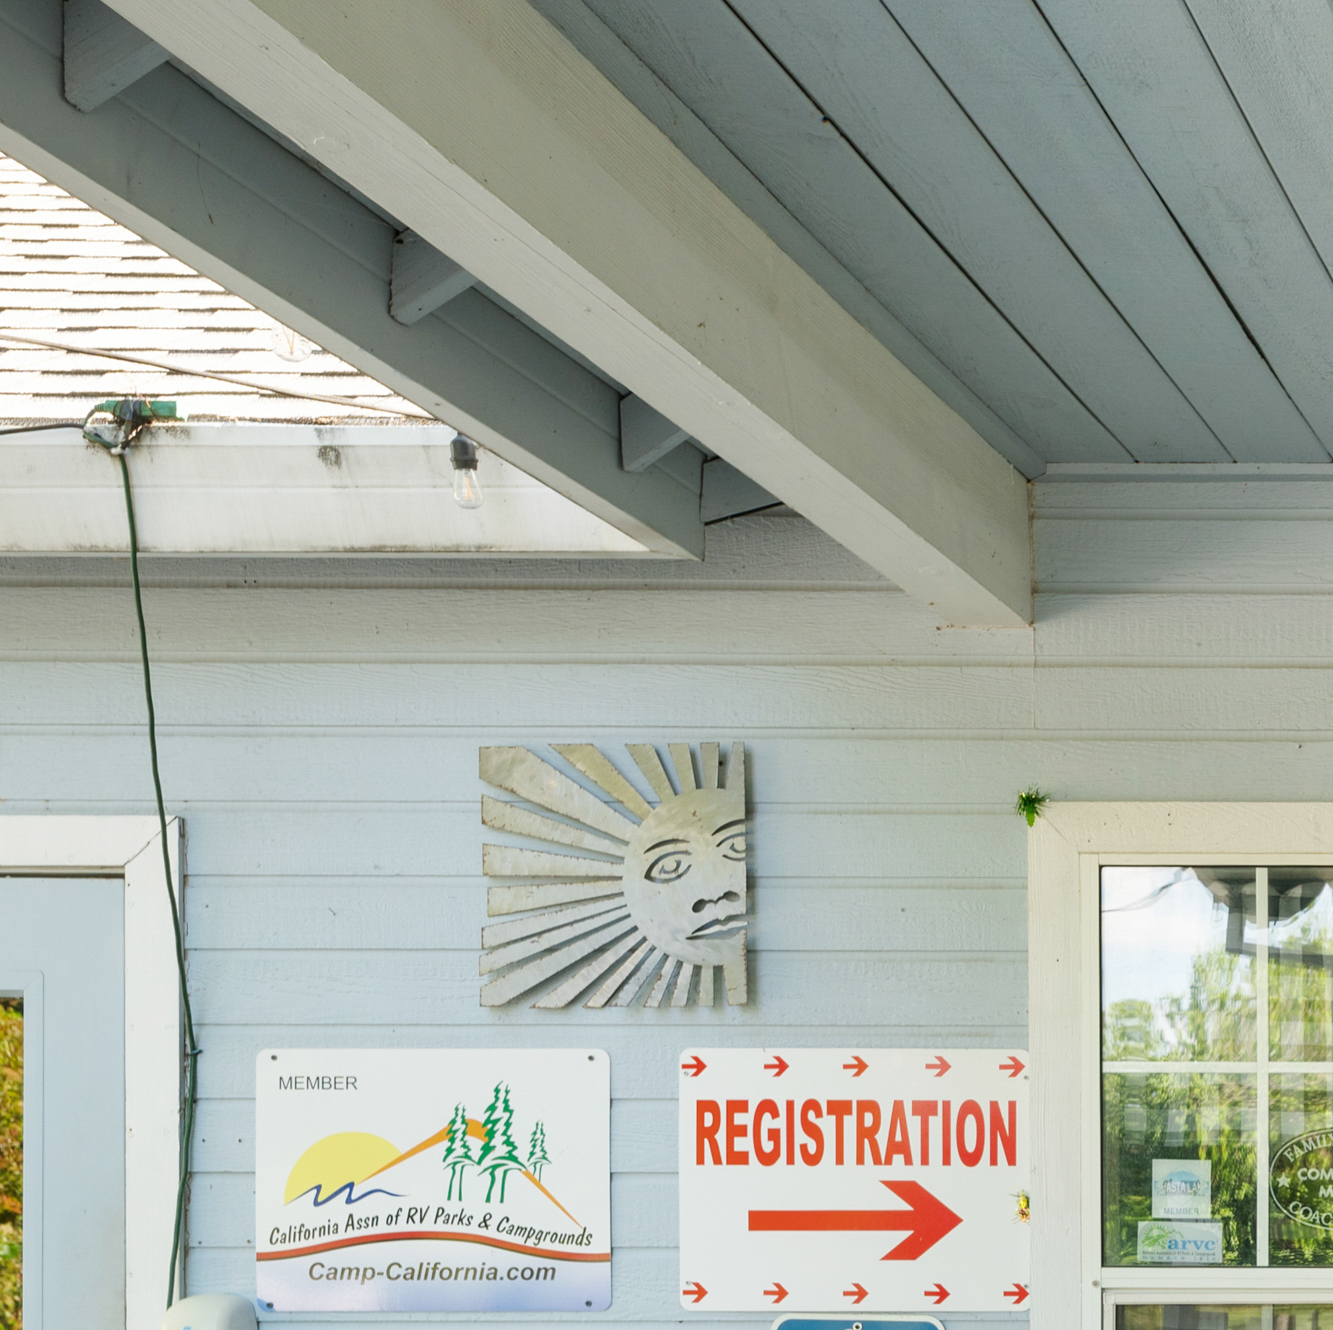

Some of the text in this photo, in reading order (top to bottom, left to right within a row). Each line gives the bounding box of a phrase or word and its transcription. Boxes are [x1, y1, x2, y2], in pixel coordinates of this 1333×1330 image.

[279, 1076, 357, 1090] MEMBER
[696, 1098, 1017, 1167] REGISTRATION
[269, 1206, 593, 1247] California Assn of RV Parks & Campgrounds
[1168, 1239, 1215, 1250] arvc
[308, 1262, 556, 1285] Camp-California.com
